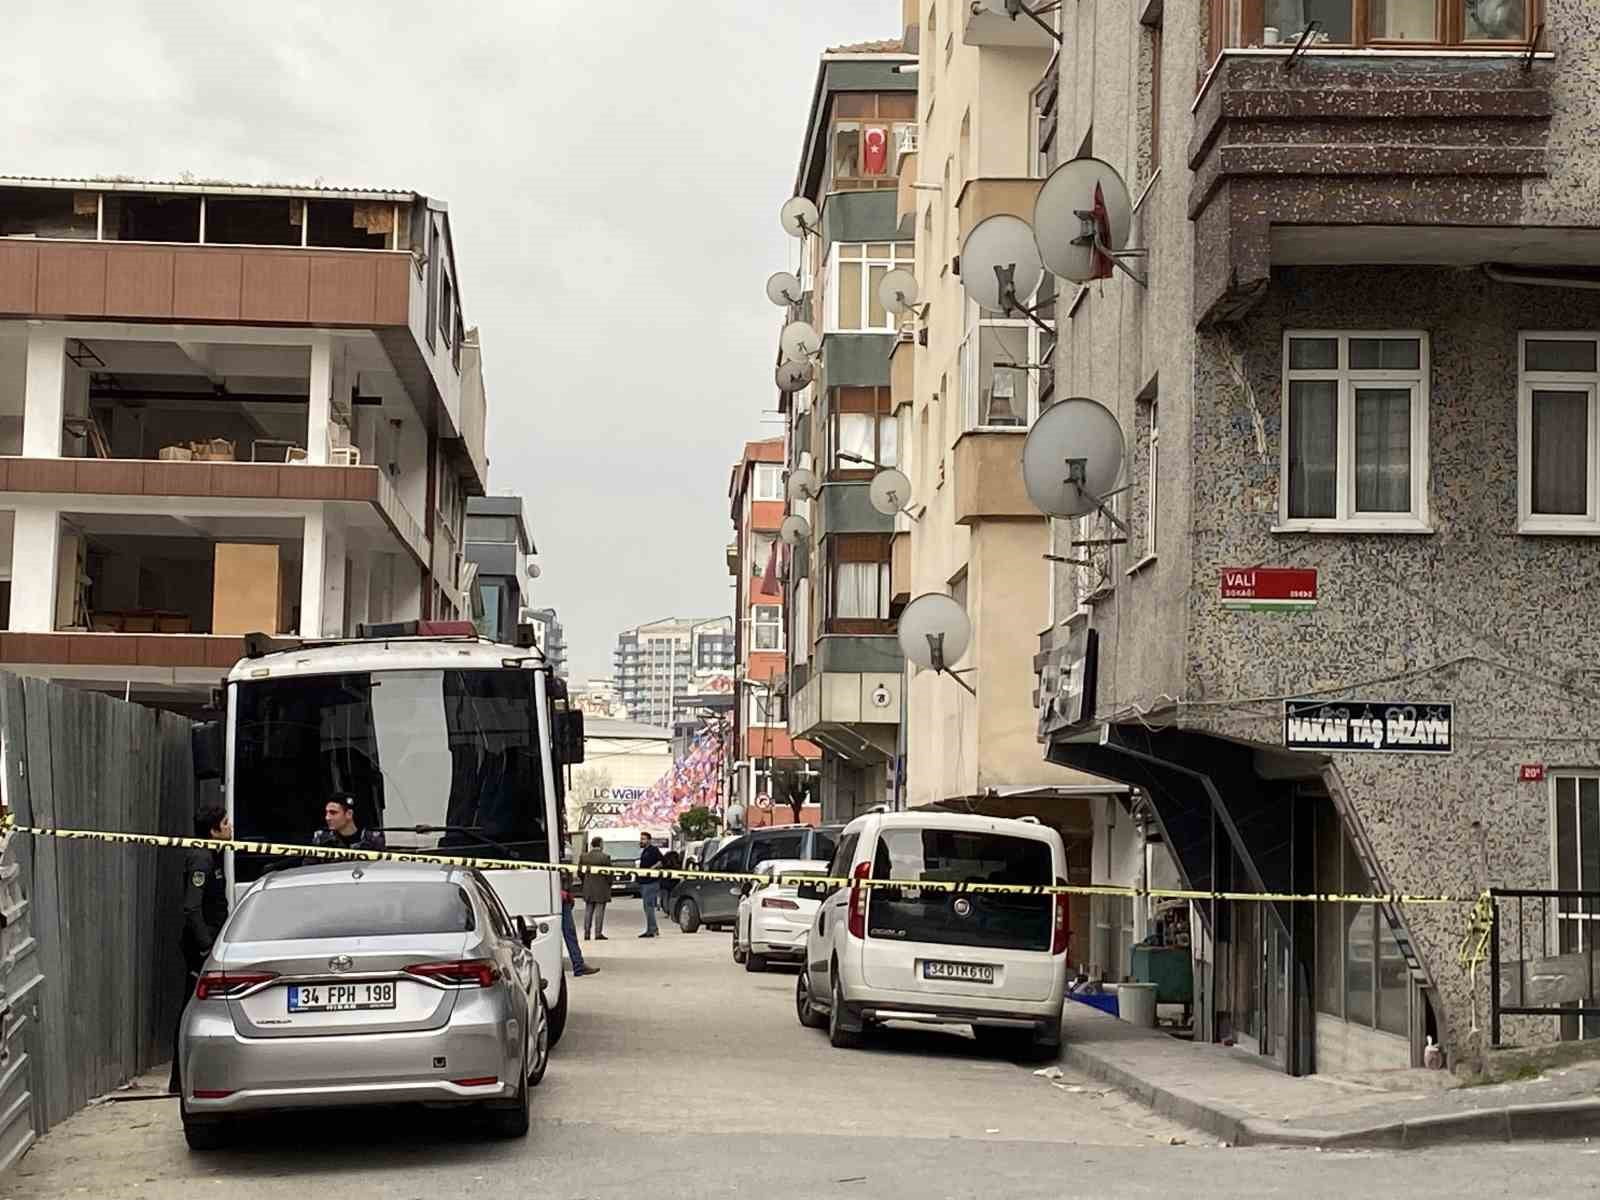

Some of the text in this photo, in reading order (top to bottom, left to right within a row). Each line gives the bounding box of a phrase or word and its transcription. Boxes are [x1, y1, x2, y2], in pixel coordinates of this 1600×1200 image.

[1288, 714, 1449, 749] HAKAN TAŞ DİZAYN
[302, 984, 391, 1004] 34 FPH 198
